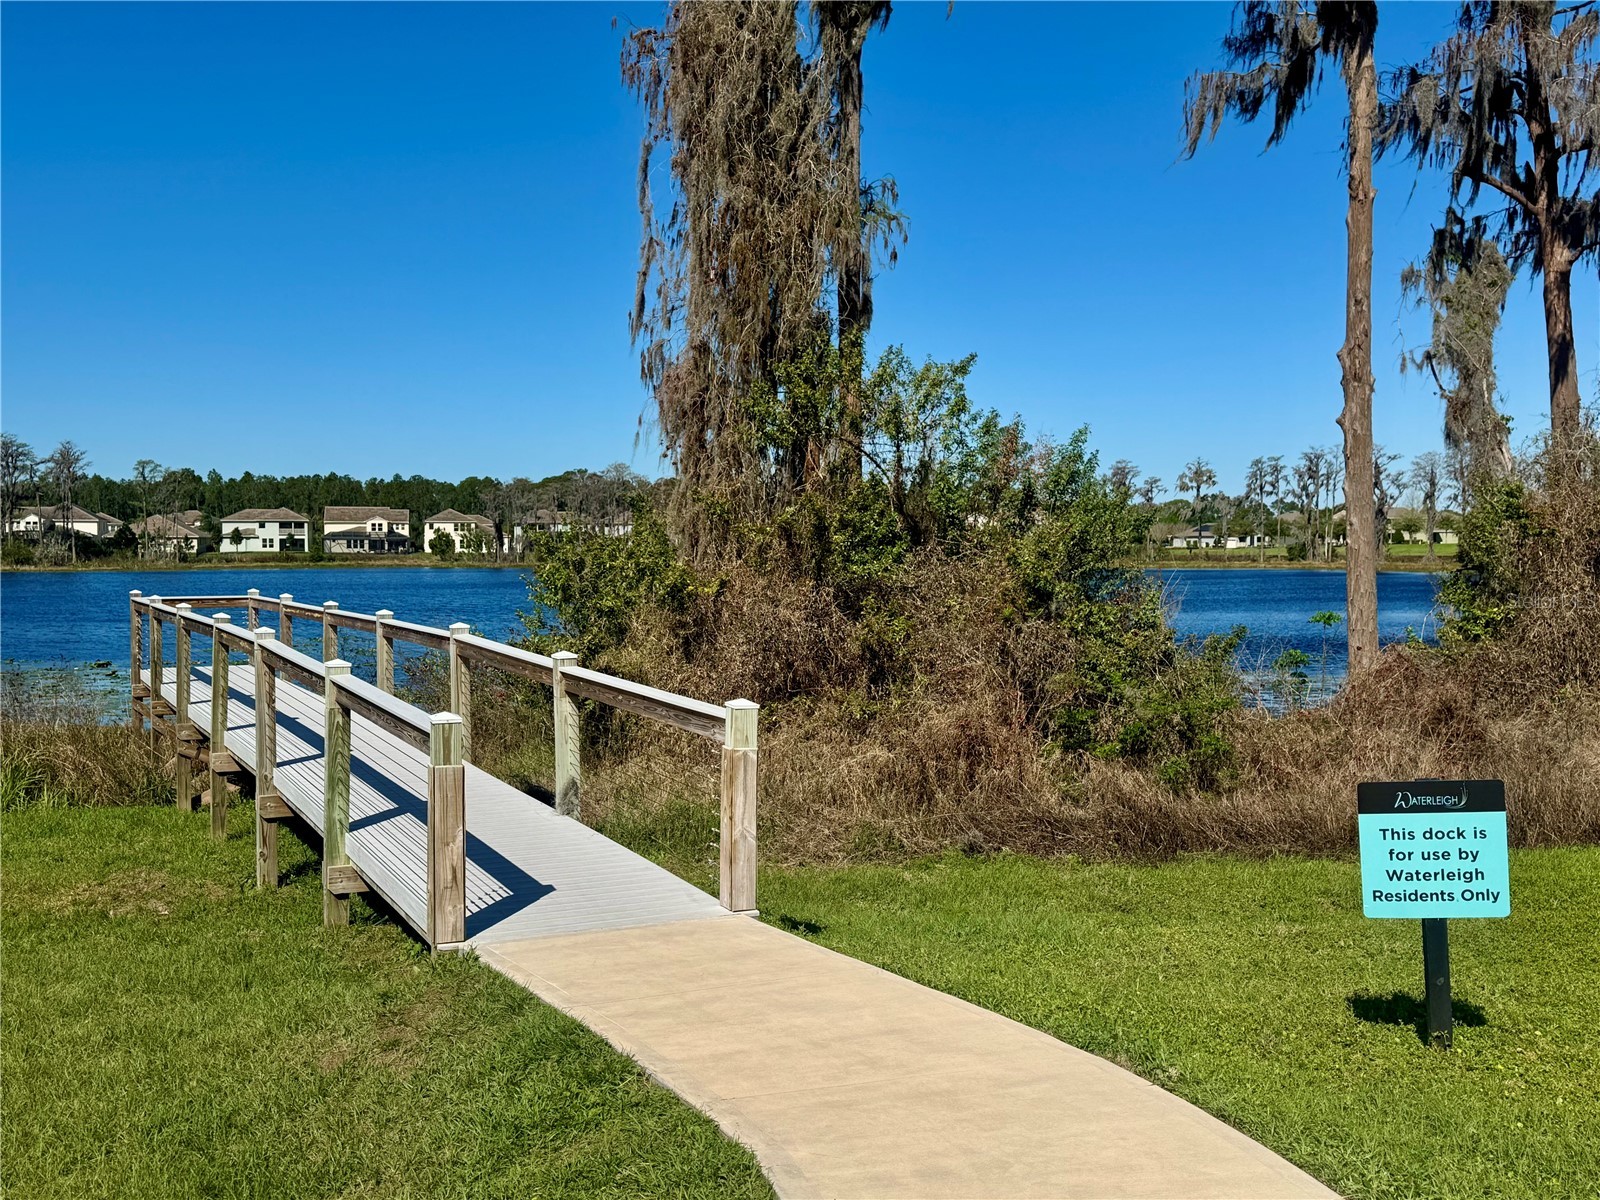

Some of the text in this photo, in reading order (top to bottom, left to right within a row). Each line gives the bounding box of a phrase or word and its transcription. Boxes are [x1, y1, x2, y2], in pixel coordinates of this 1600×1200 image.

[1379, 827, 1487, 841] This dock is
[1388, 848, 1479, 863] for use by
[1386, 868, 1485, 883] Waterleigh
[1372, 888, 1500, 903] Residents Only
